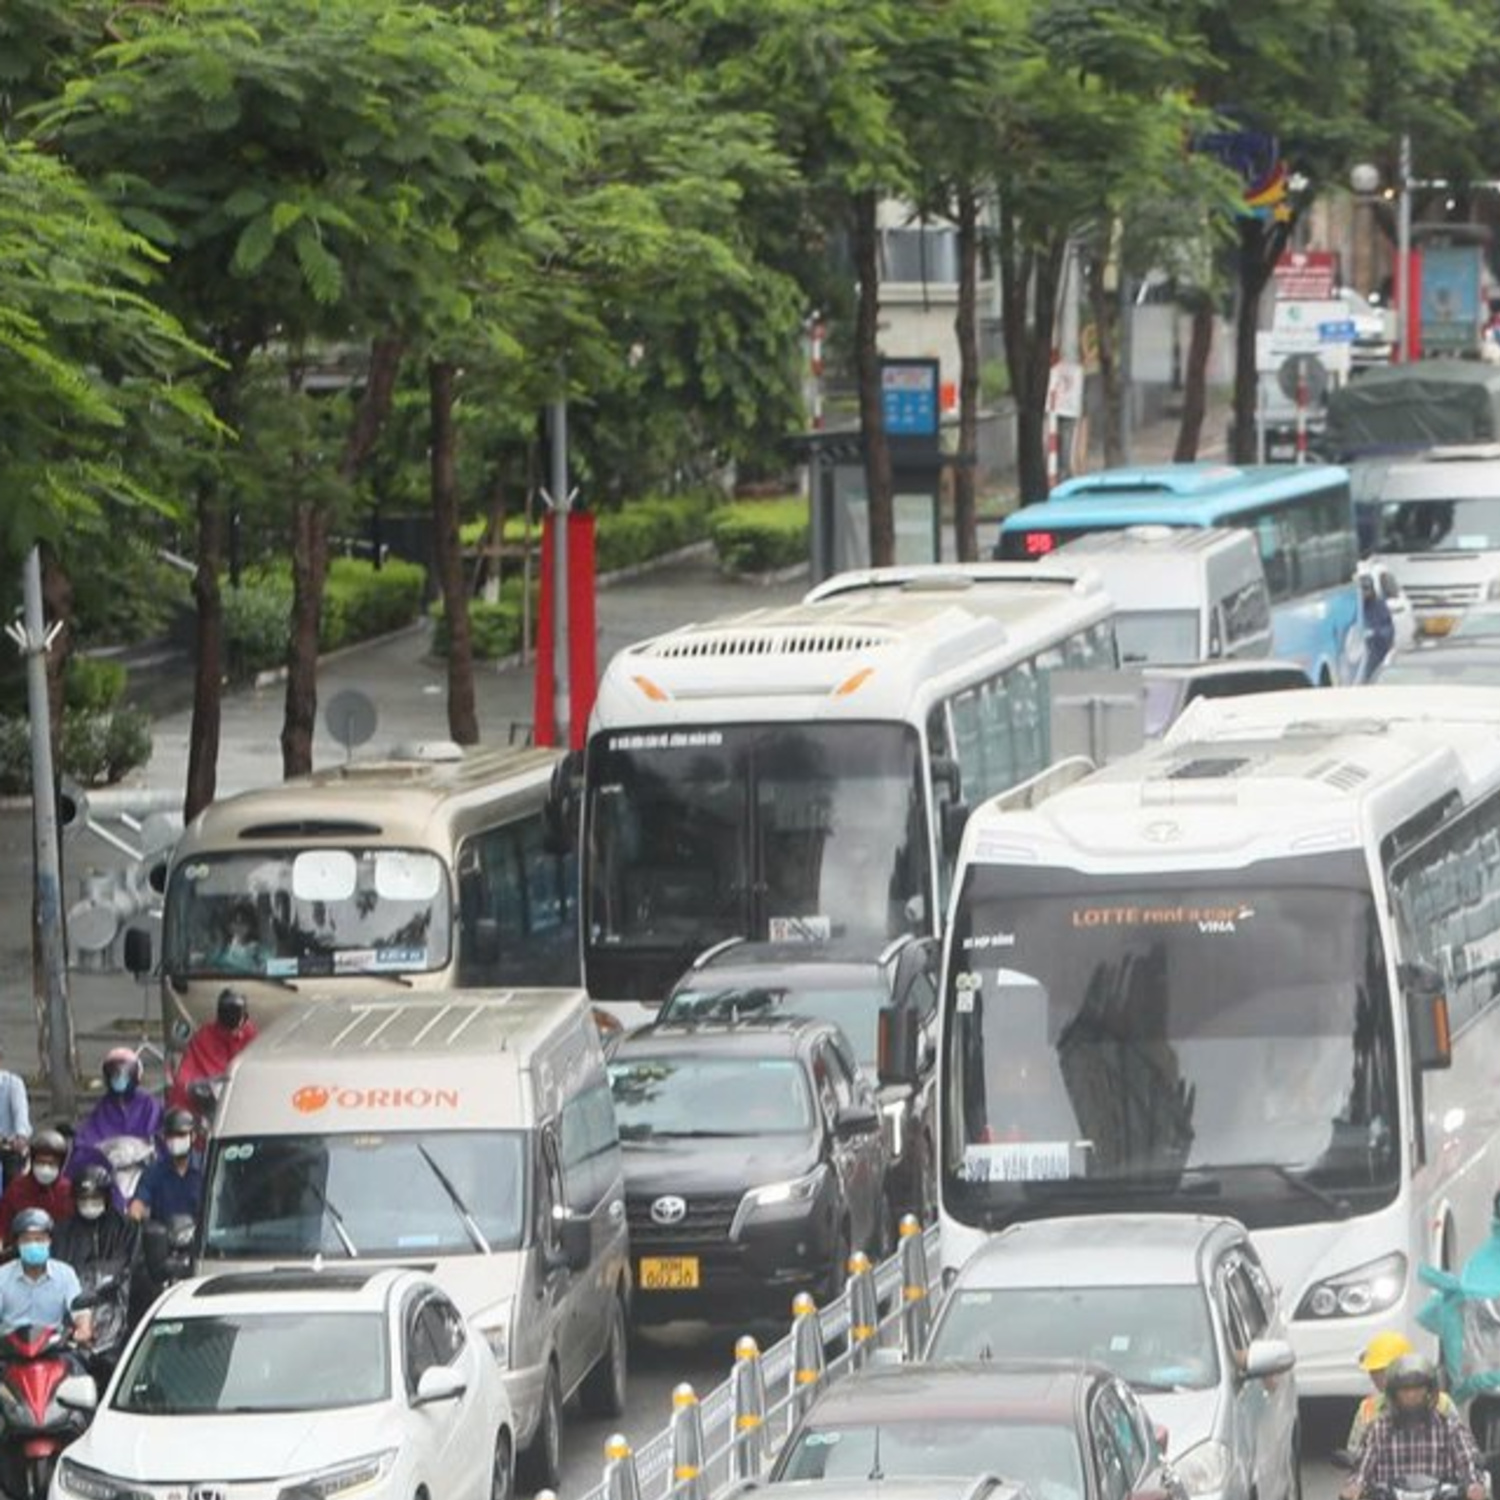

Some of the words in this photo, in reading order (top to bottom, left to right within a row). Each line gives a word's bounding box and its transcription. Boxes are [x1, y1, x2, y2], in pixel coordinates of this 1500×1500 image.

[1073, 909, 1137, 926] LOTTE
[1143, 907, 1183, 922] rent
[1202, 908, 1237, 921] car
[1199, 921, 1235, 932] VINA
[338, 1088, 458, 1107] ORION
